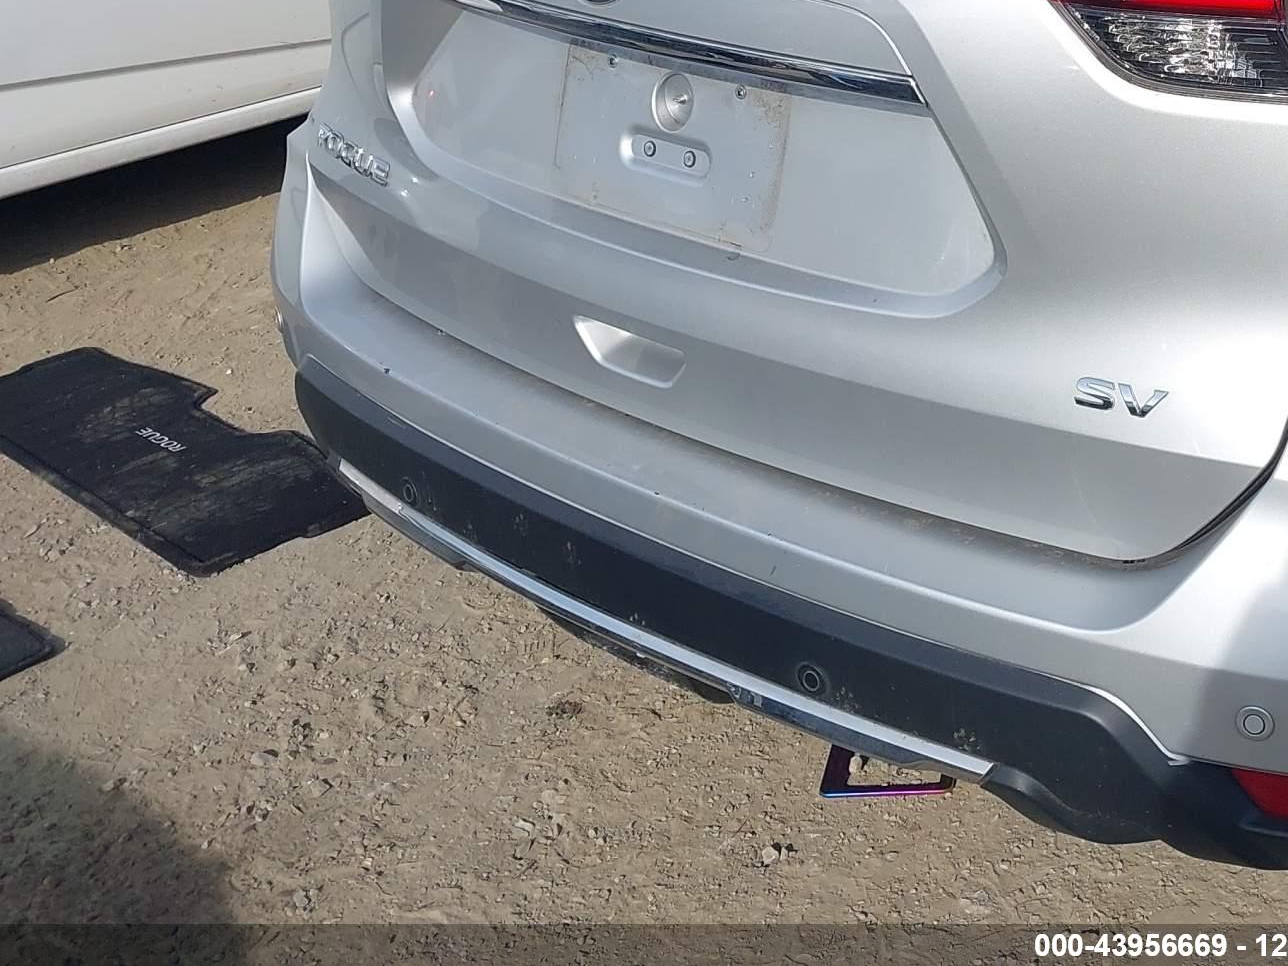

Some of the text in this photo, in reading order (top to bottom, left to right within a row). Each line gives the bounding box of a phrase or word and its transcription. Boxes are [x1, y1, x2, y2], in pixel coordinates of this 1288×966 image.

[318, 123, 391, 188] ROGUE
[1073, 376, 1170, 419] SV
[135, 426, 187, 452] ROGUE
